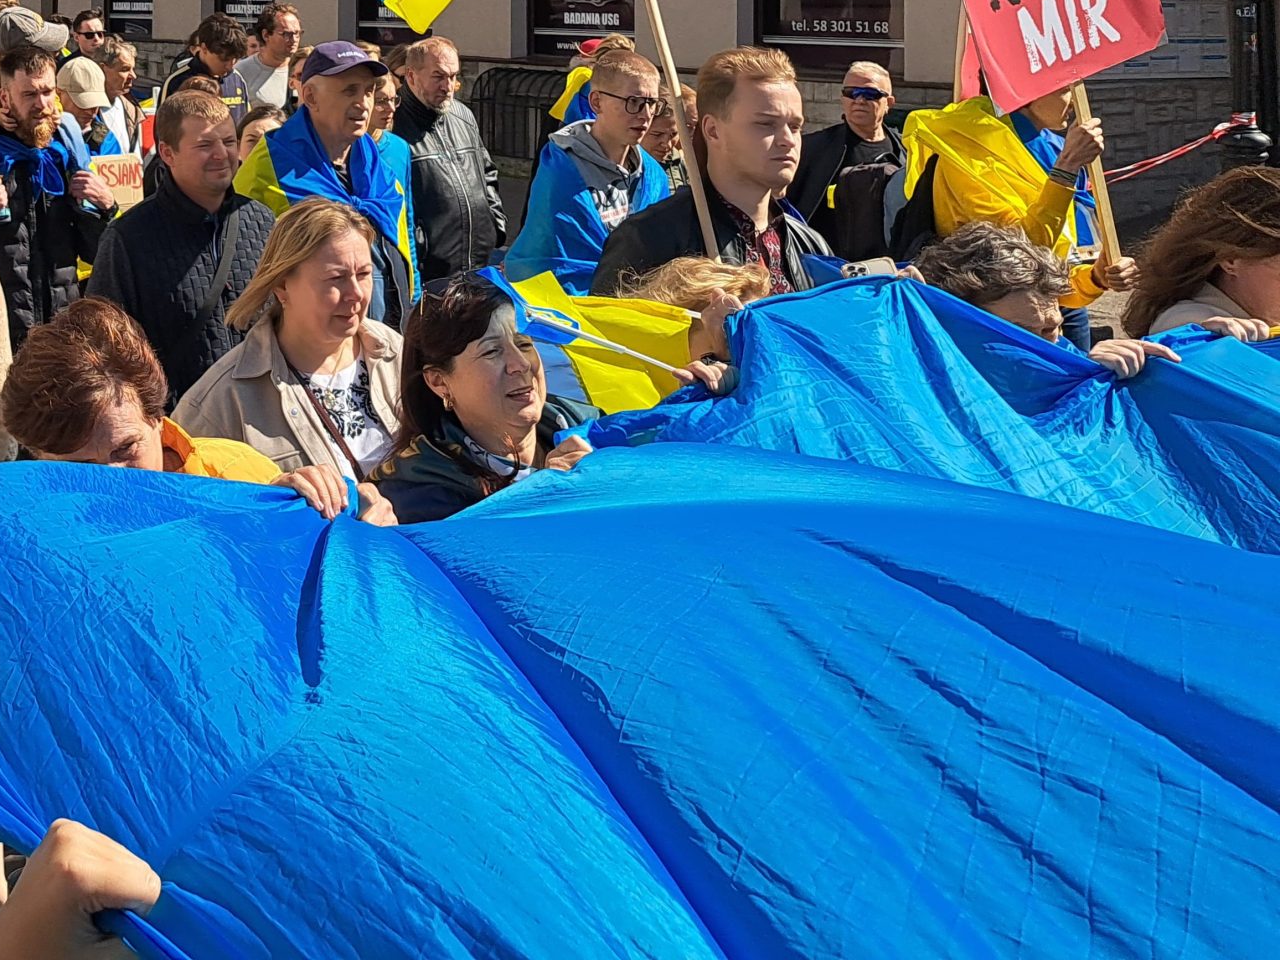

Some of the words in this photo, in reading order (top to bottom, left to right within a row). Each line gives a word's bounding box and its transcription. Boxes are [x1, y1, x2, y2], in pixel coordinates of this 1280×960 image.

[564, 12, 600, 25] BADANIA
[601, 13, 620, 26] USG
[791, 19, 810, 31] tel.
[813, 20, 827, 32] 58
[830, 21, 852, 32] 301
[855, 21, 870, 33] 51
[874, 22, 889, 33] 68
[97, 161, 144, 189] SSIANS
